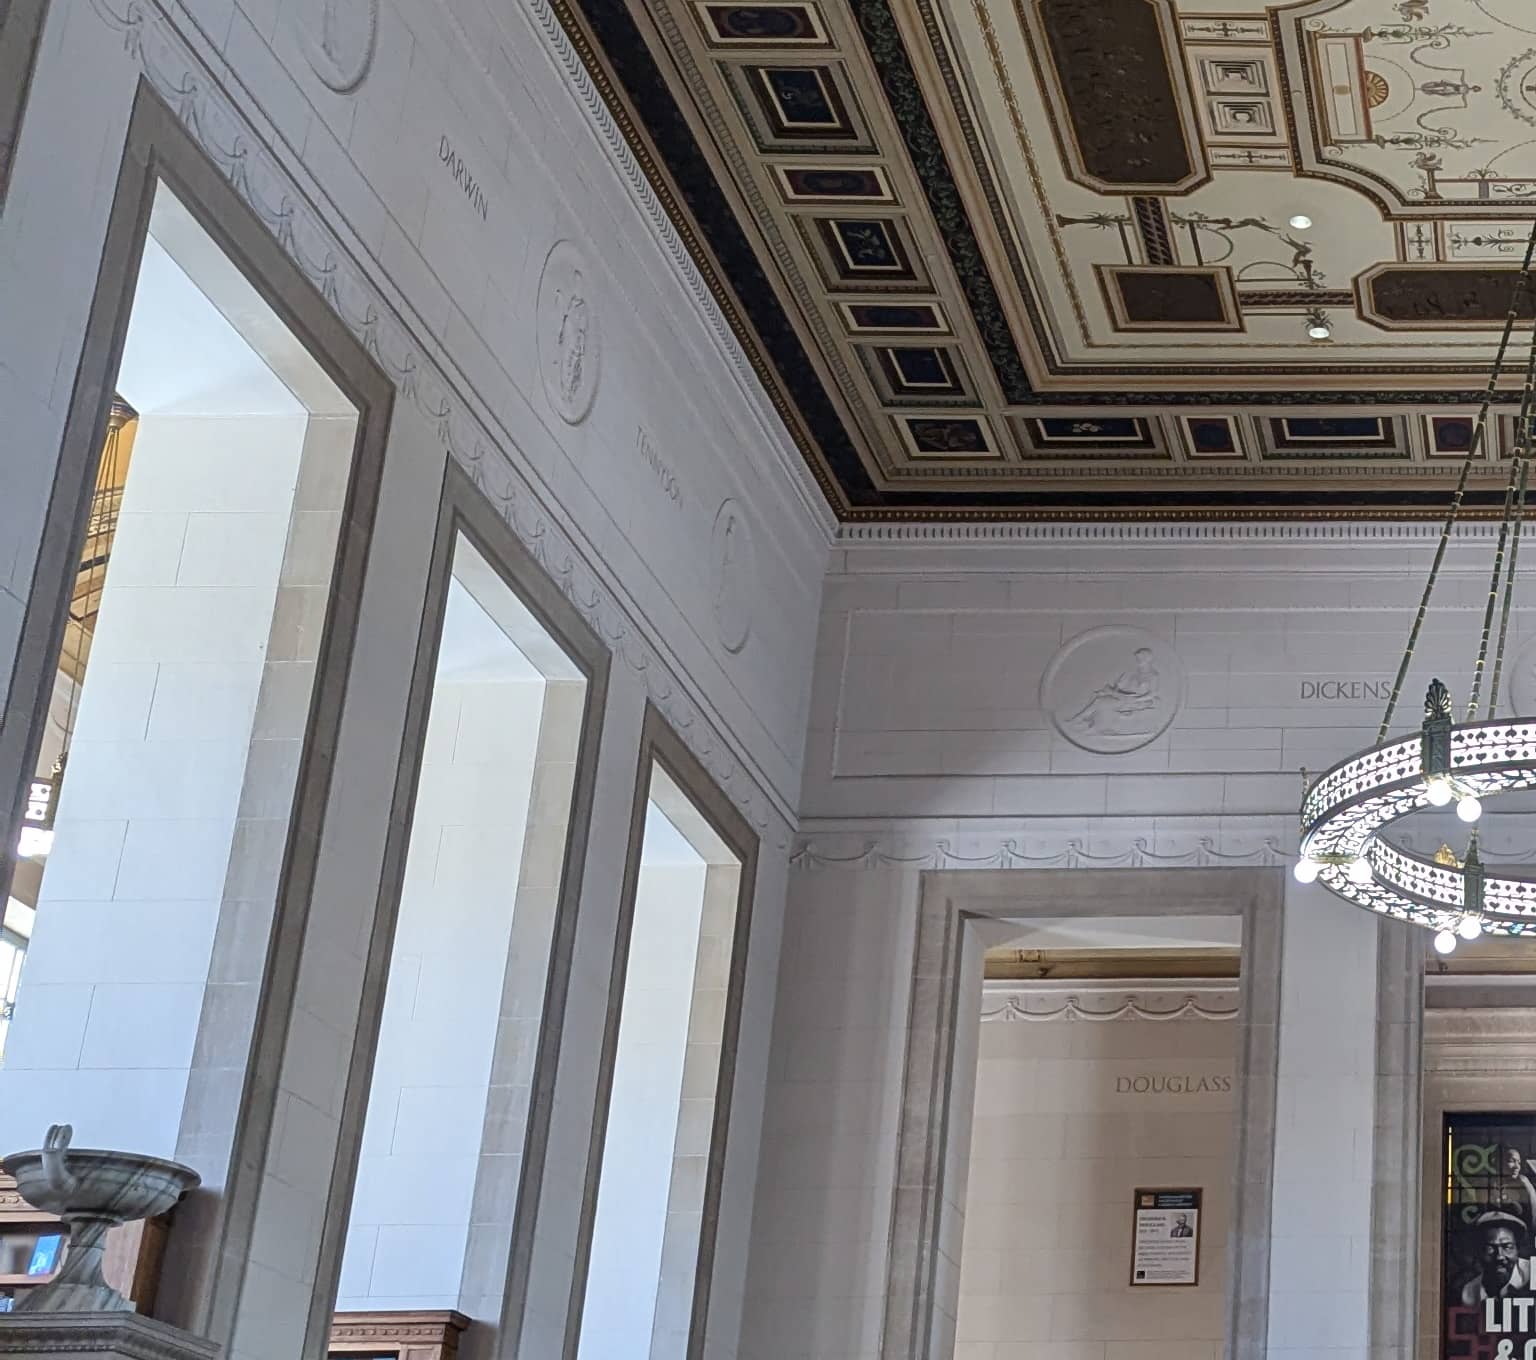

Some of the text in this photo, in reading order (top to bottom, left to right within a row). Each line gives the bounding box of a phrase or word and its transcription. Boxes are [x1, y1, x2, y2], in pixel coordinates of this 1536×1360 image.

[439, 135, 488, 221] DARWIN
[1301, 681, 1391, 700] DICKENS
[1116, 1075, 1232, 1094] DOUGLASS
